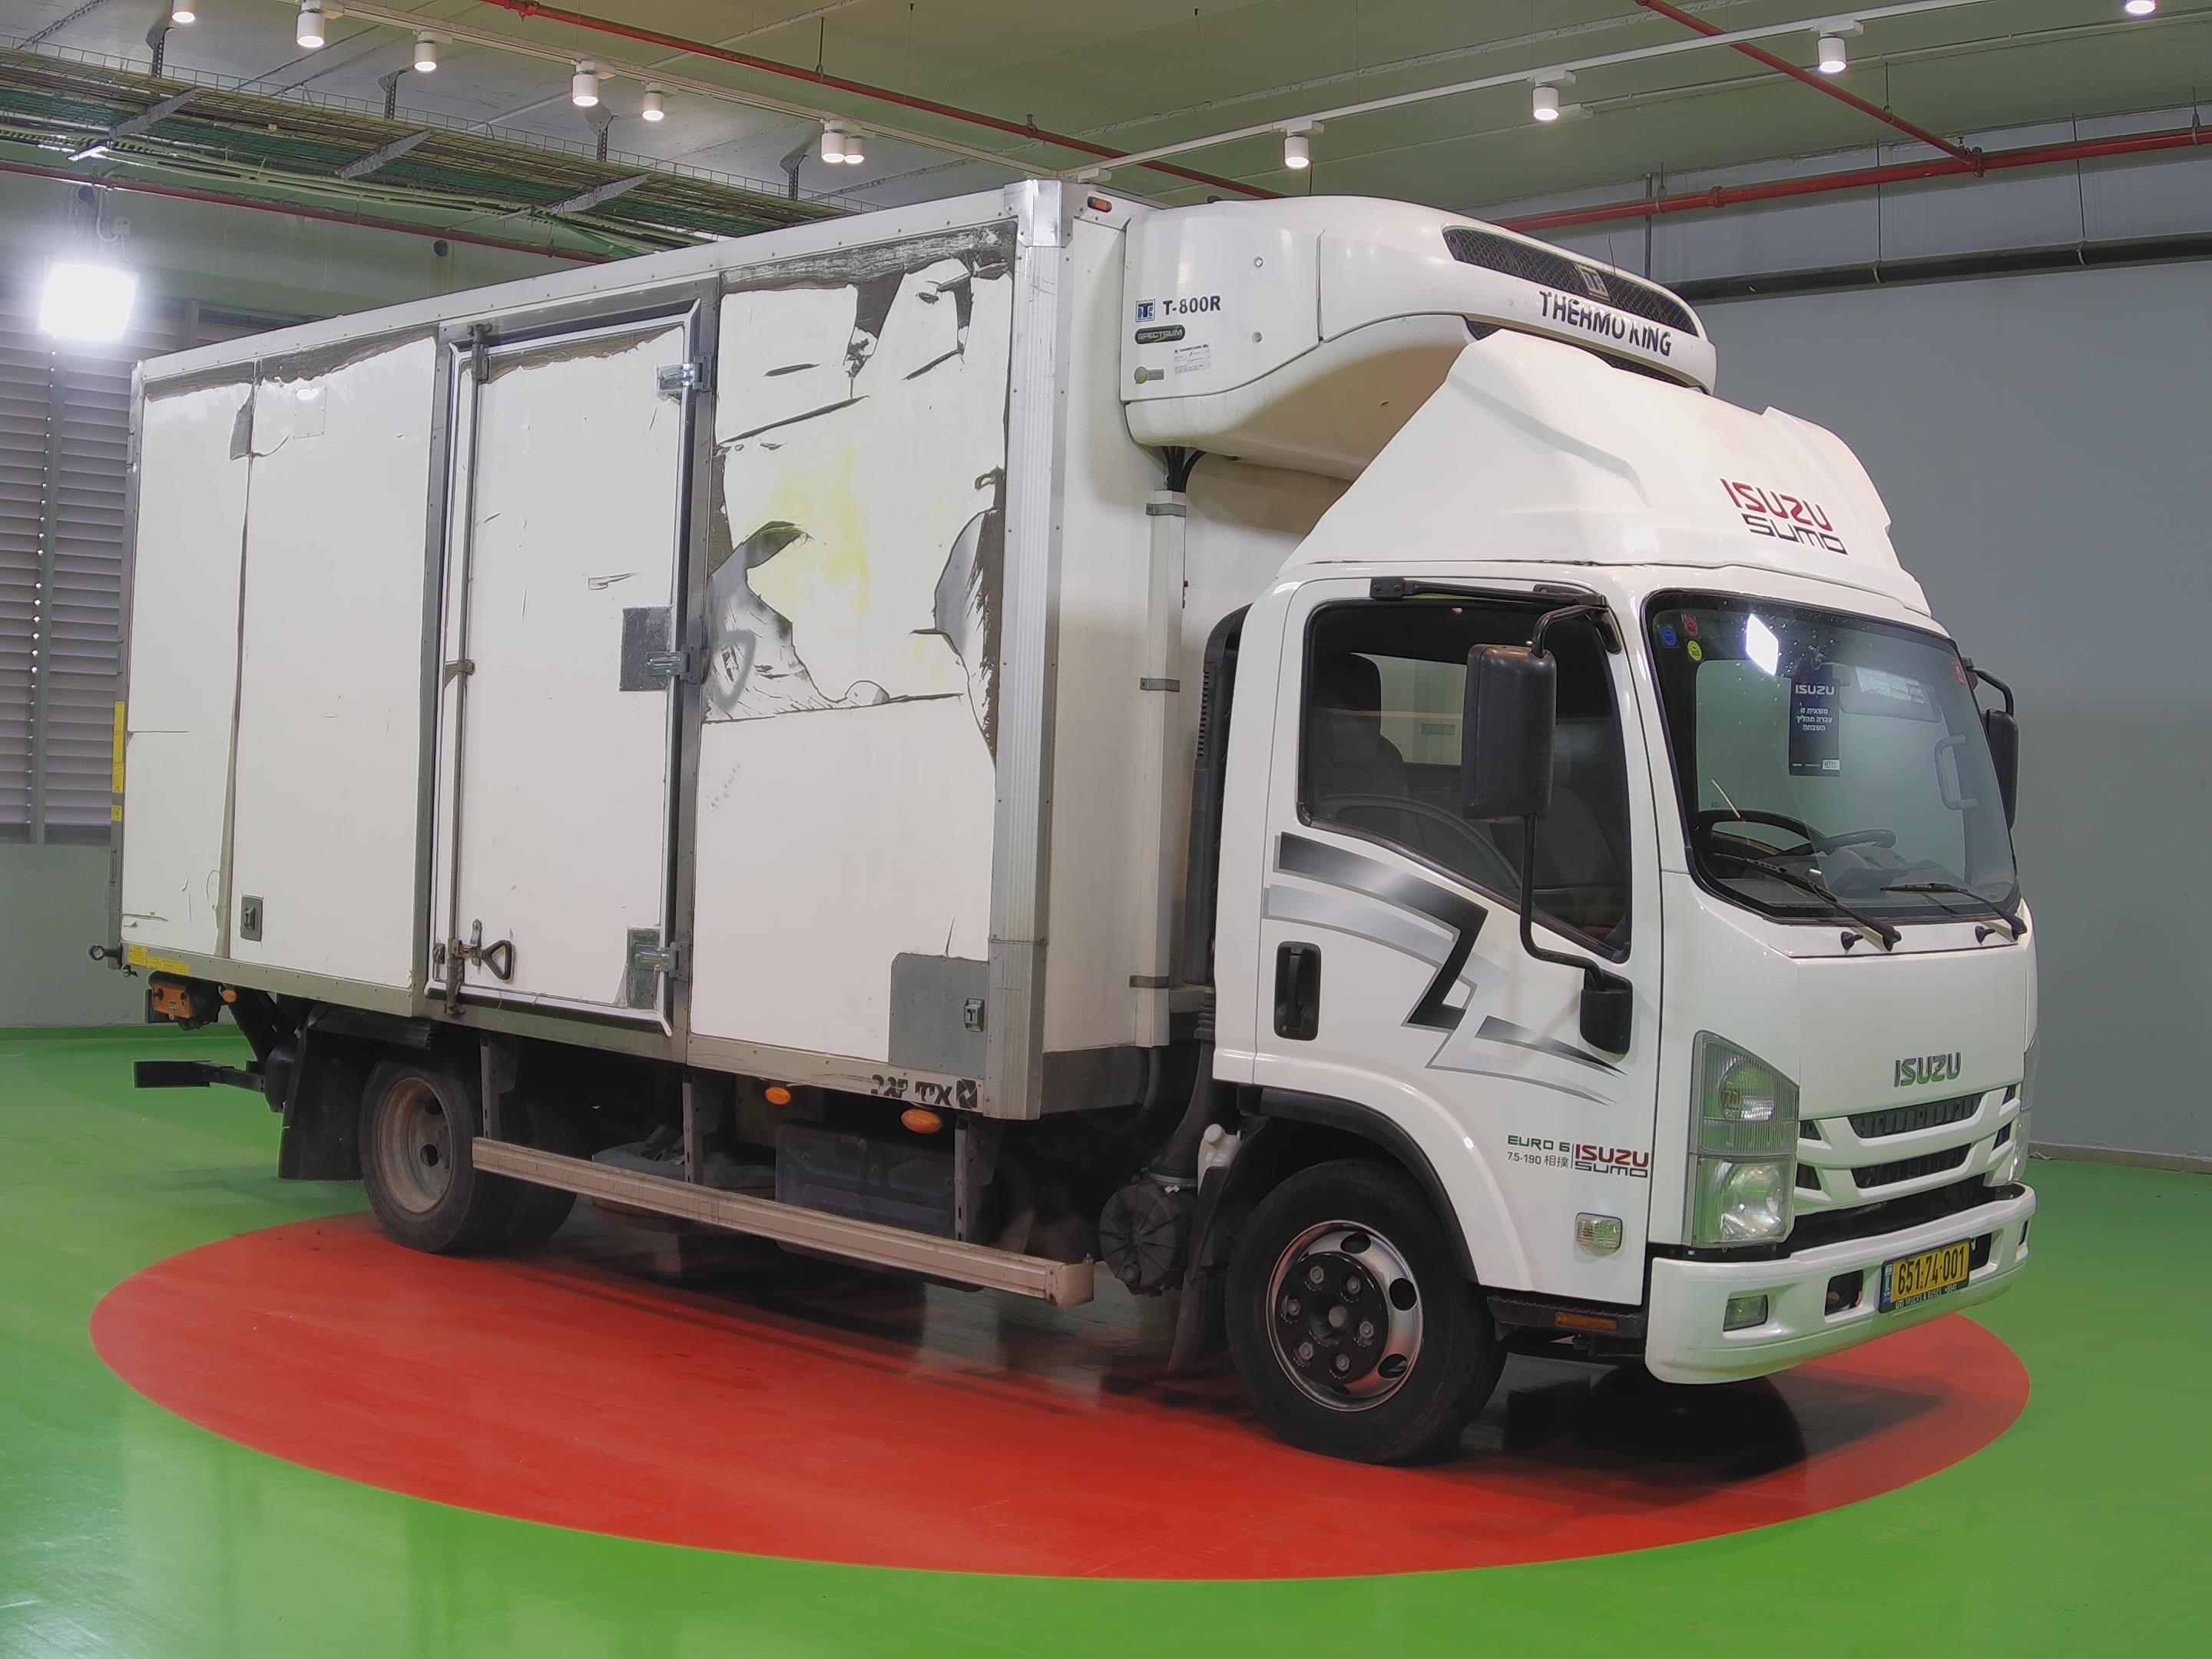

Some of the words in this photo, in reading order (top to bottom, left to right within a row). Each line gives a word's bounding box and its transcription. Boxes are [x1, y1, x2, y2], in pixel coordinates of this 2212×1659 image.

[1162, 295, 1221, 316] T-800R
[1137, 329, 1183, 340] SPECTRUM
[1538, 290, 1625, 339] THERMO
[1629, 324, 1672, 357] KING
[1720, 478, 1833, 531] ISUZU
[1740, 512, 1849, 556] SUMO
[1795, 684, 1835, 695] ISUZU
[1894, 1052, 1961, 1088] ISUZU
[1508, 1134, 1554, 1151] EURO
[1558, 1142, 1571, 1153] 6
[1575, 1144, 1649, 1167] ISUZU
[1575, 1161, 1648, 1178] SUMO
